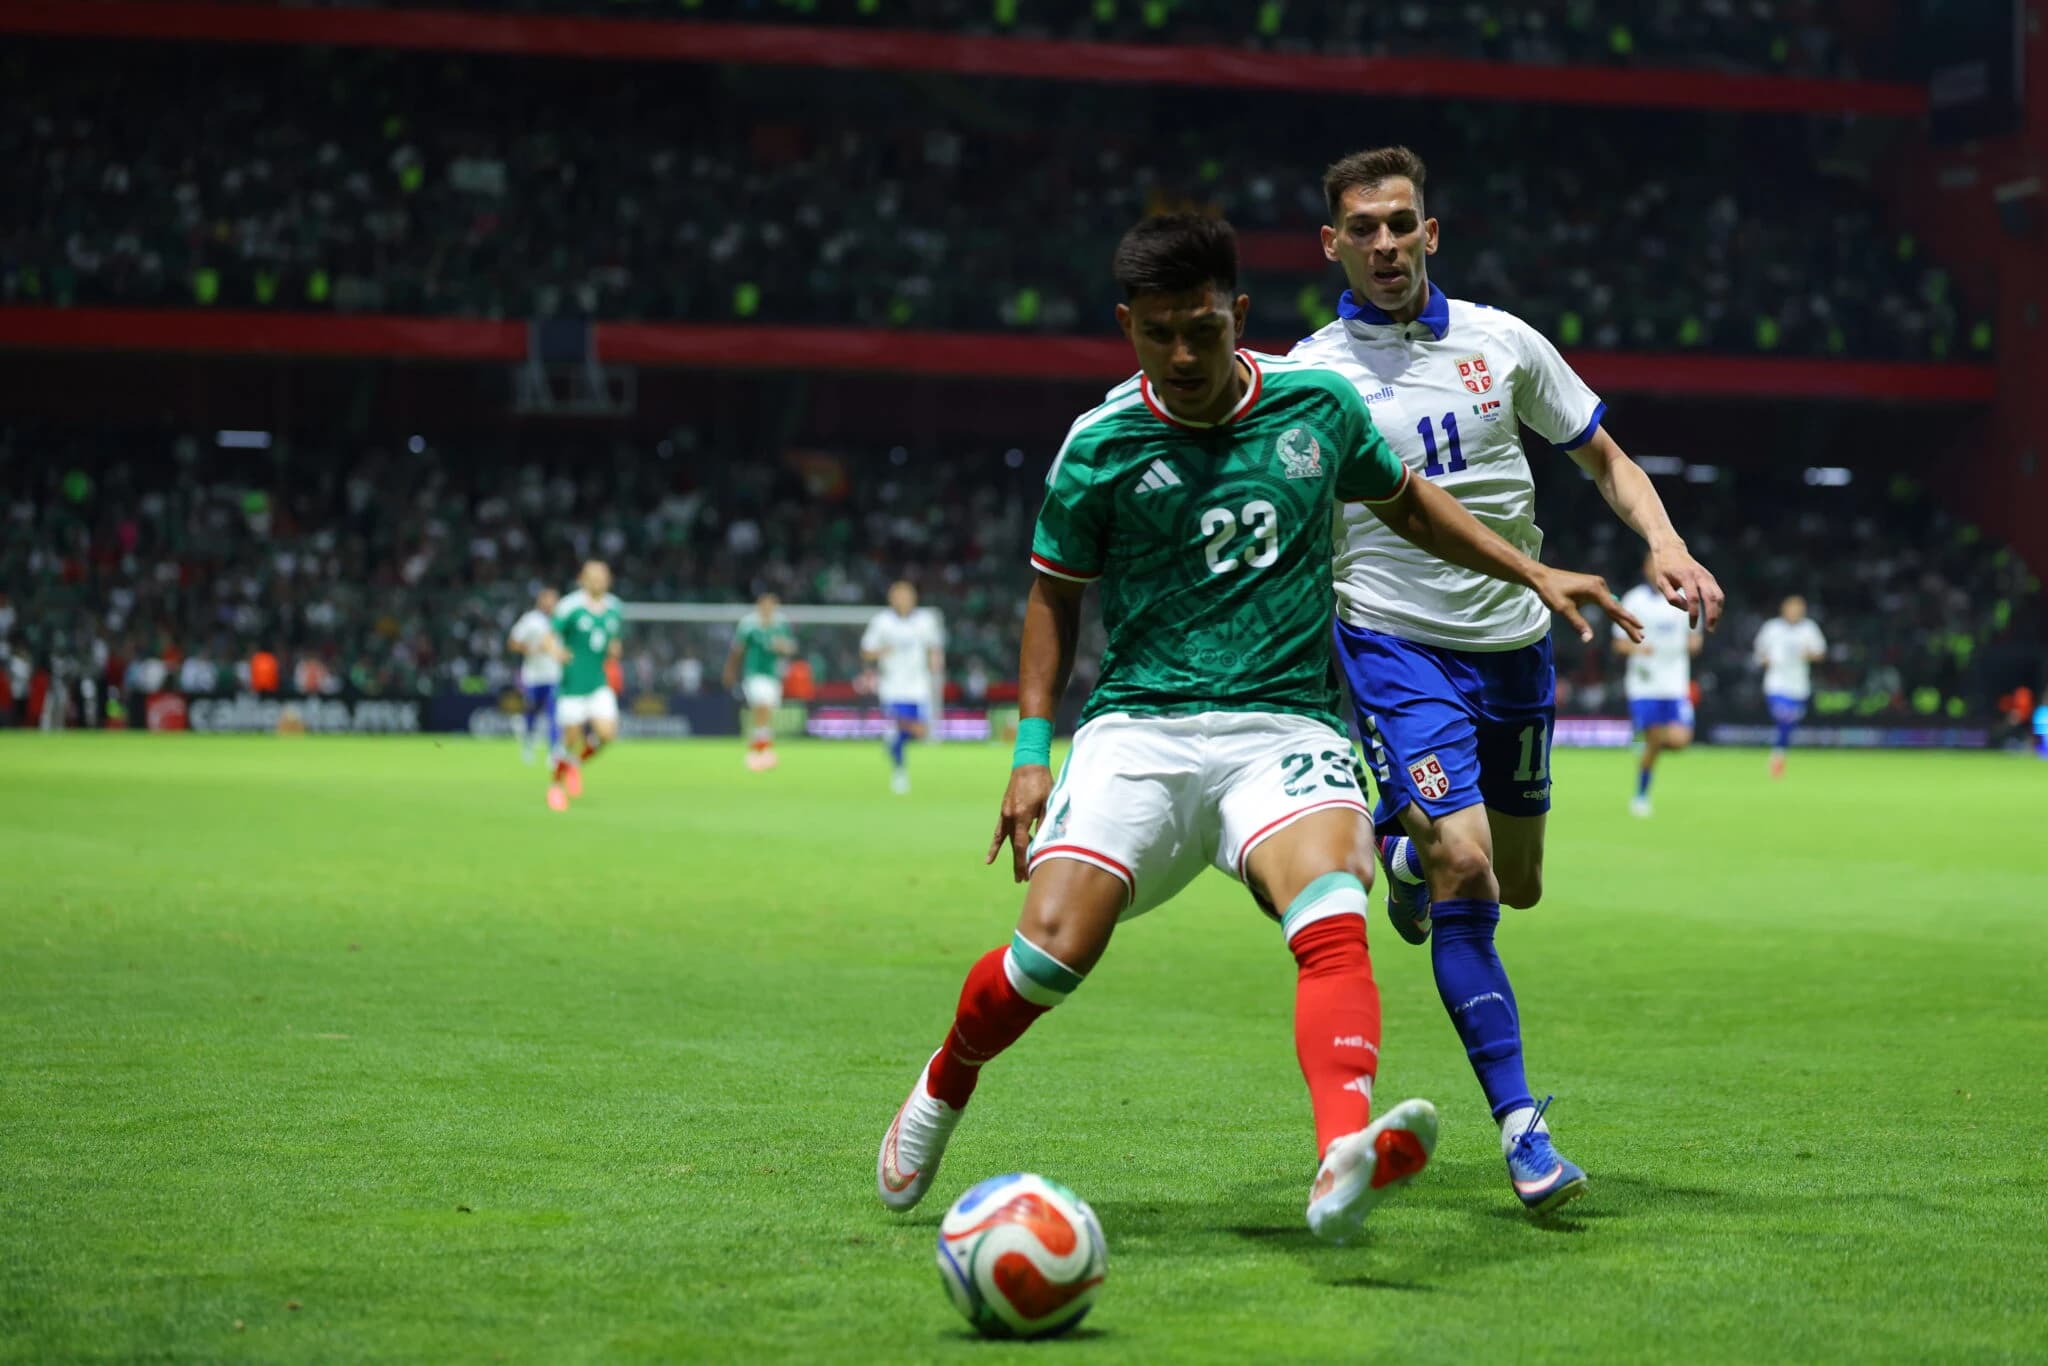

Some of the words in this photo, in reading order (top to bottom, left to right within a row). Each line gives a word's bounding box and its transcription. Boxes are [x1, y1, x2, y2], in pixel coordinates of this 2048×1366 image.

[1362, 386, 1394, 404] pelli
[1417, 411, 1467, 477] 11
[1201, 500, 1278, 574] 23
[1281, 750, 1355, 796] 23
[1513, 725, 1547, 781] 11
